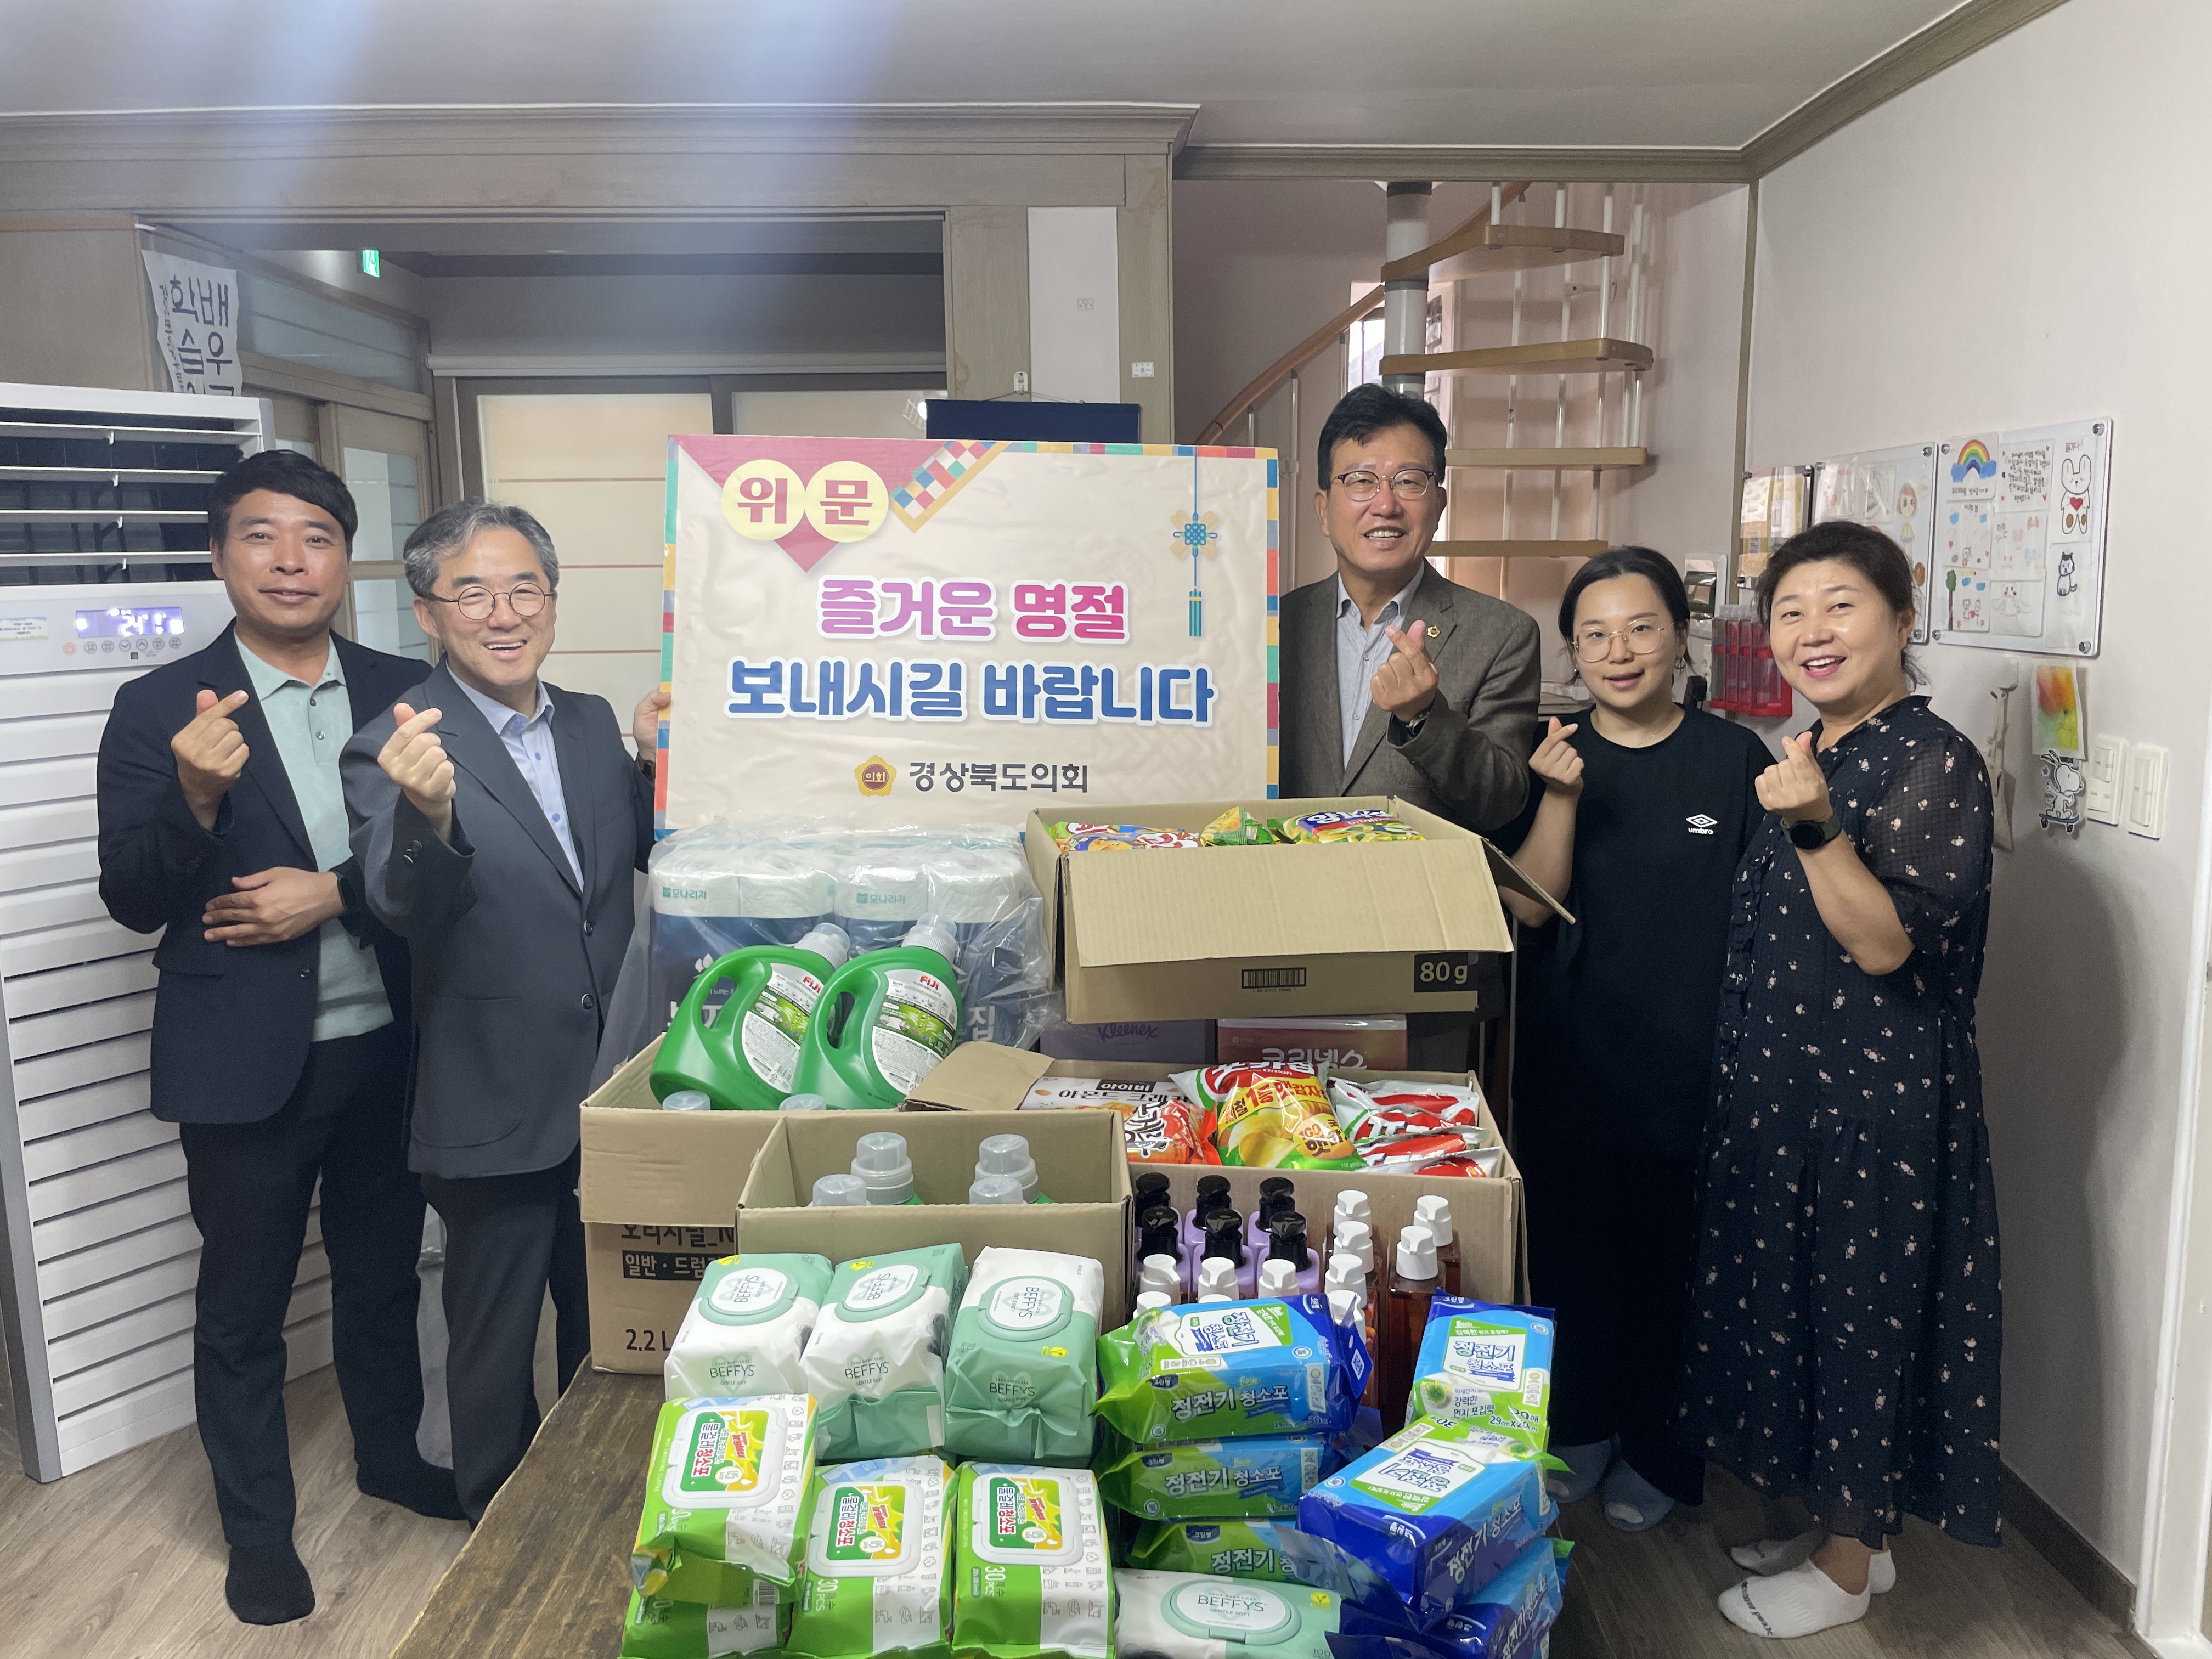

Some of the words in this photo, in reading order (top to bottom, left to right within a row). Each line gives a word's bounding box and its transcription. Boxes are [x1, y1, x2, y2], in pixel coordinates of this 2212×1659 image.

[819, 579, 996, 638] 즐거운
[1012, 582, 1127, 640] 명절
[727, 659, 964, 719] 보내시길
[984, 664, 1215, 723] 바랍니다
[864, 772, 886, 783] 의회
[909, 762, 1087, 793] 경상북도의회
[672, 888, 708, 900] 모나리자
[870, 894, 906, 905] 모나리자
[1097, 1022, 1159, 1042] Kleenex
[1059, 1090, 1120, 1101] 아몬드
[1100, 1082, 1151, 1092] 아이비
[1246, 1083, 1274, 1108] 1등
[625, 1254, 657, 1277] 일반
[733, 1274, 760, 1303] BEFFYS
[866, 1273, 891, 1301] BEFFYS
[1018, 1286, 1040, 1317] BEFFYS
[1203, 1324, 1229, 1350] 청소포
[1222, 1312, 1260, 1347] 정전기
[1453, 1340, 1516, 1362] 정전기
[709, 1364, 755, 1378] BEFFYS
[844, 1361, 889, 1379] BEFFYS
[1466, 1358, 1514, 1373] 청소포
[989, 1383, 1035, 1397] BEFFYS
[1171, 1387, 1237, 1421] 정전기
[1239, 1385, 1289, 1408] 청소포
[1454, 1395, 1478, 1408] 강력한
[1453, 1408, 1470, 1419] 먼지
[1471, 1404, 1494, 1418] 포집력
[1165, 1466, 1229, 1497] 정전기
[1234, 1465, 1283, 1487] 청소포
[1378, 1463, 1451, 1492] 정전기
[1447, 1521, 1488, 1584] 정전기
[1490, 1494, 1522, 1538] 청소포
[1211, 1548, 1275, 1574] 정전기
[984, 1566, 1006, 1581] 30
[817, 1579, 838, 1592] 30
[985, 1581, 995, 1596] PCS
[815, 1593, 825, 1611] PCS
[1198, 1594, 1264, 1612] BEFFYS
[1312, 1648, 1331, 1657] 100
